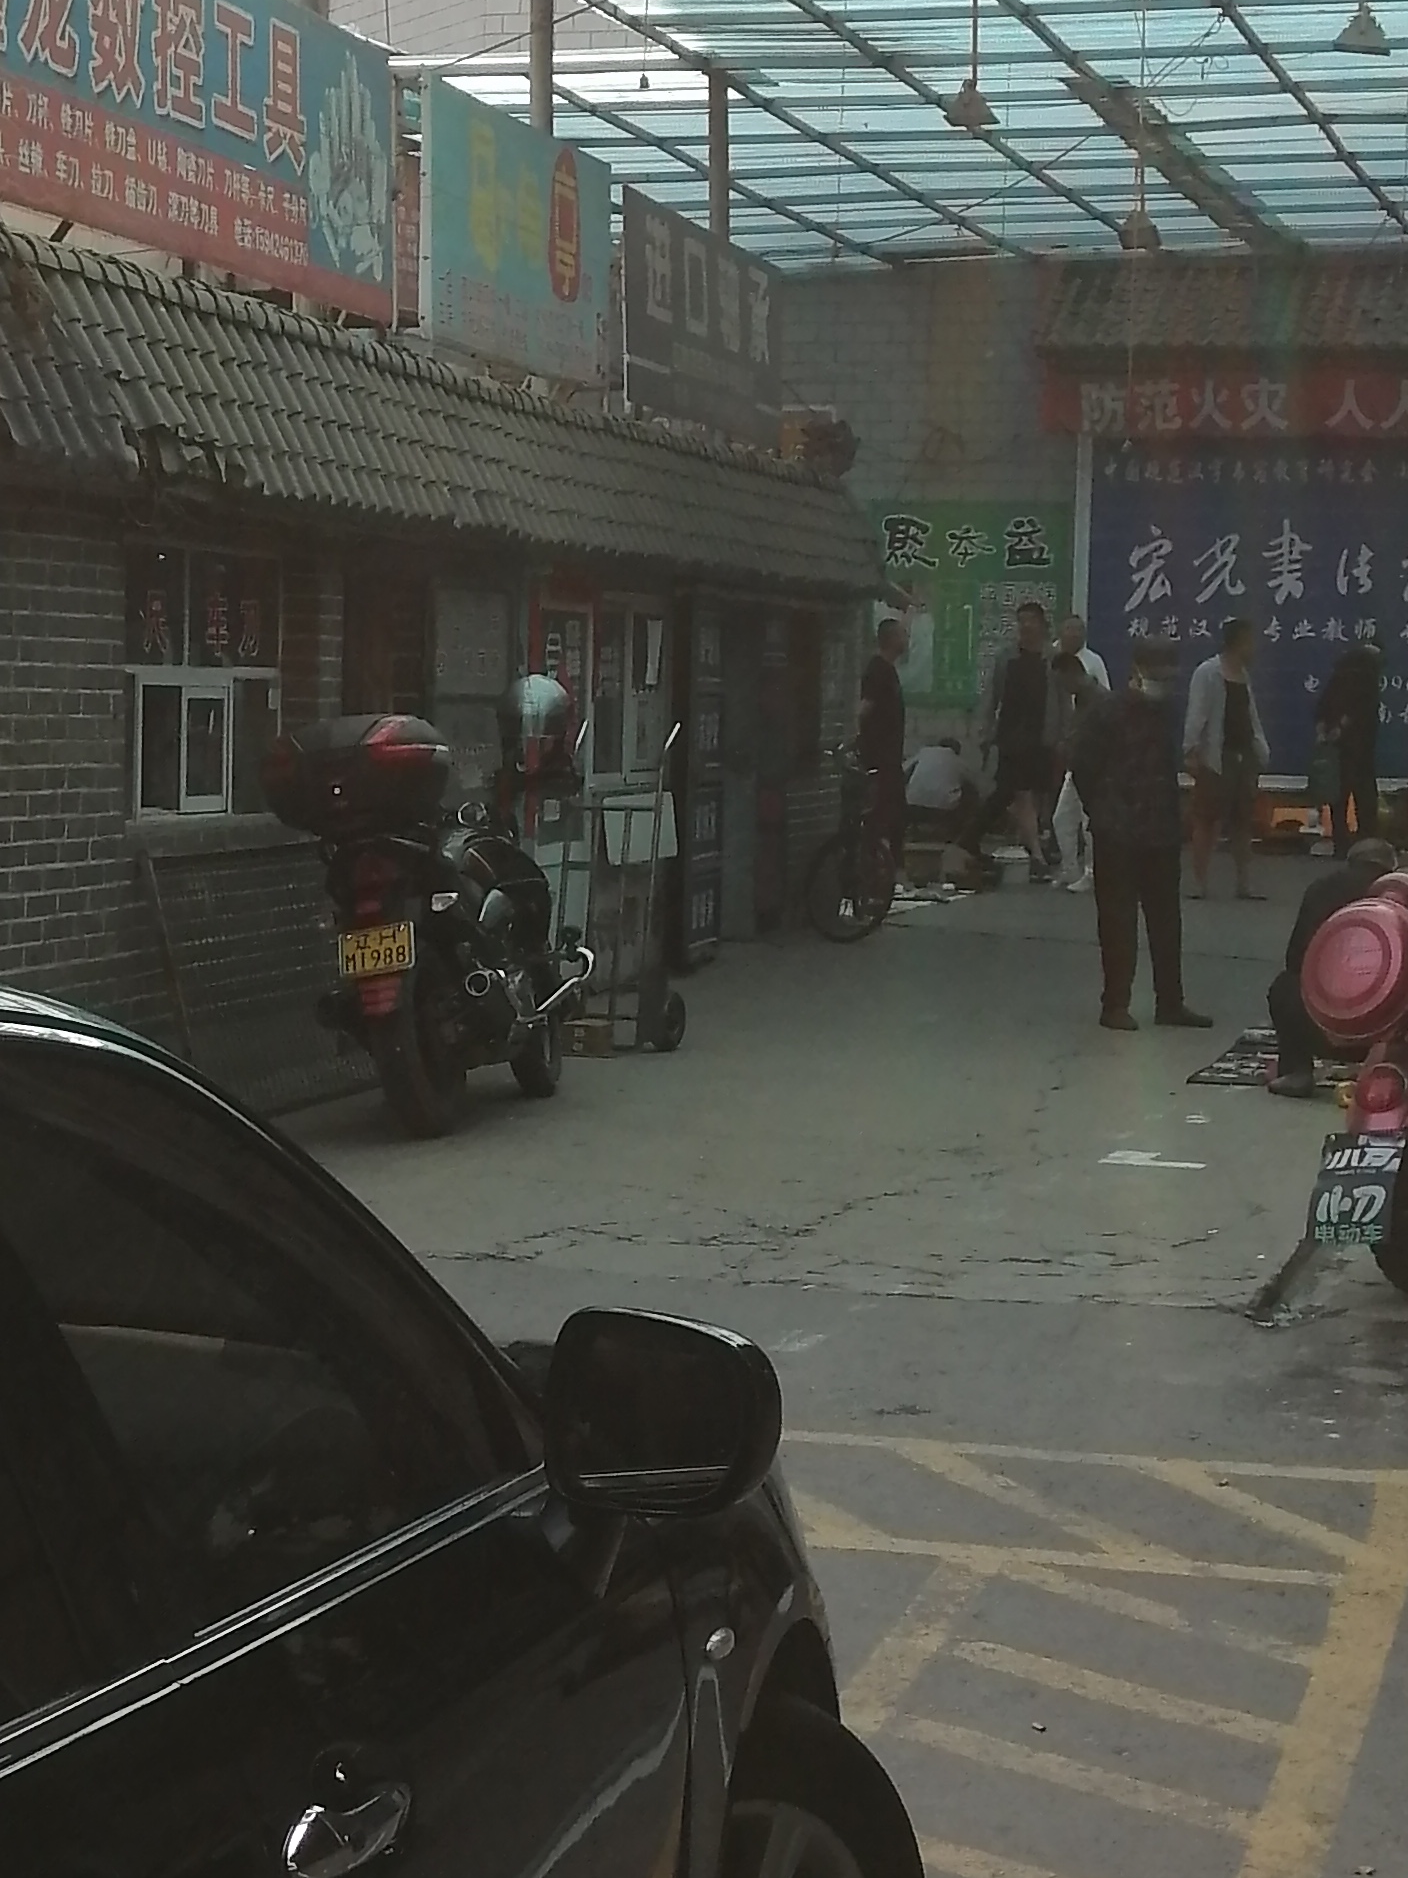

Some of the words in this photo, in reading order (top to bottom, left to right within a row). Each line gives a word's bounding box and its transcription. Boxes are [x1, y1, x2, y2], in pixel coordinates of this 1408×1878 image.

[1079, 377, 1288, 434] 防范火灾
[345, 944, 407, 972] M1988
